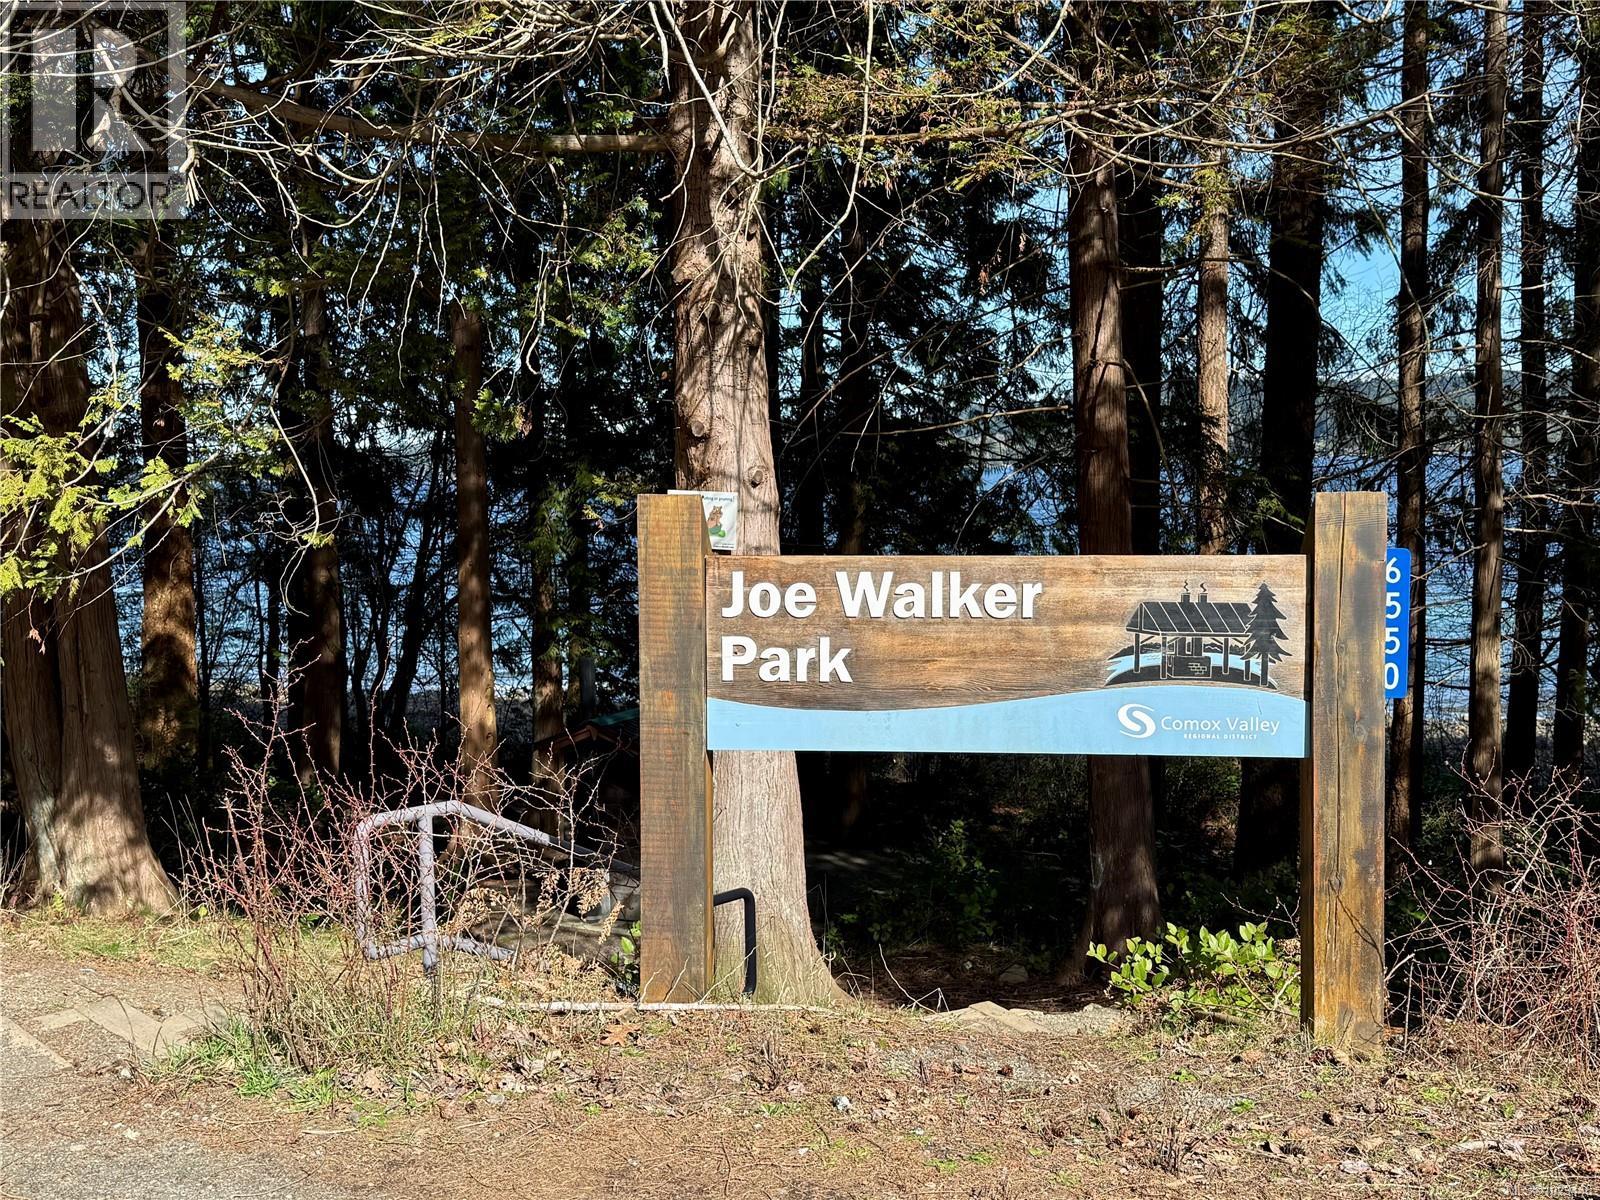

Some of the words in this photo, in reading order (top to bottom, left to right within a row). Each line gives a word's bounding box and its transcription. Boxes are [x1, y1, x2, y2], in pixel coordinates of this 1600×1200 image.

[721, 570, 817, 619] Joe
[835, 570, 1043, 619] Walker
[1384, 556, 1402, 690] 6550
[721, 635, 853, 683] Park
[1161, 716, 1221, 731] Comox
[1226, 716, 1280, 736] Valley
